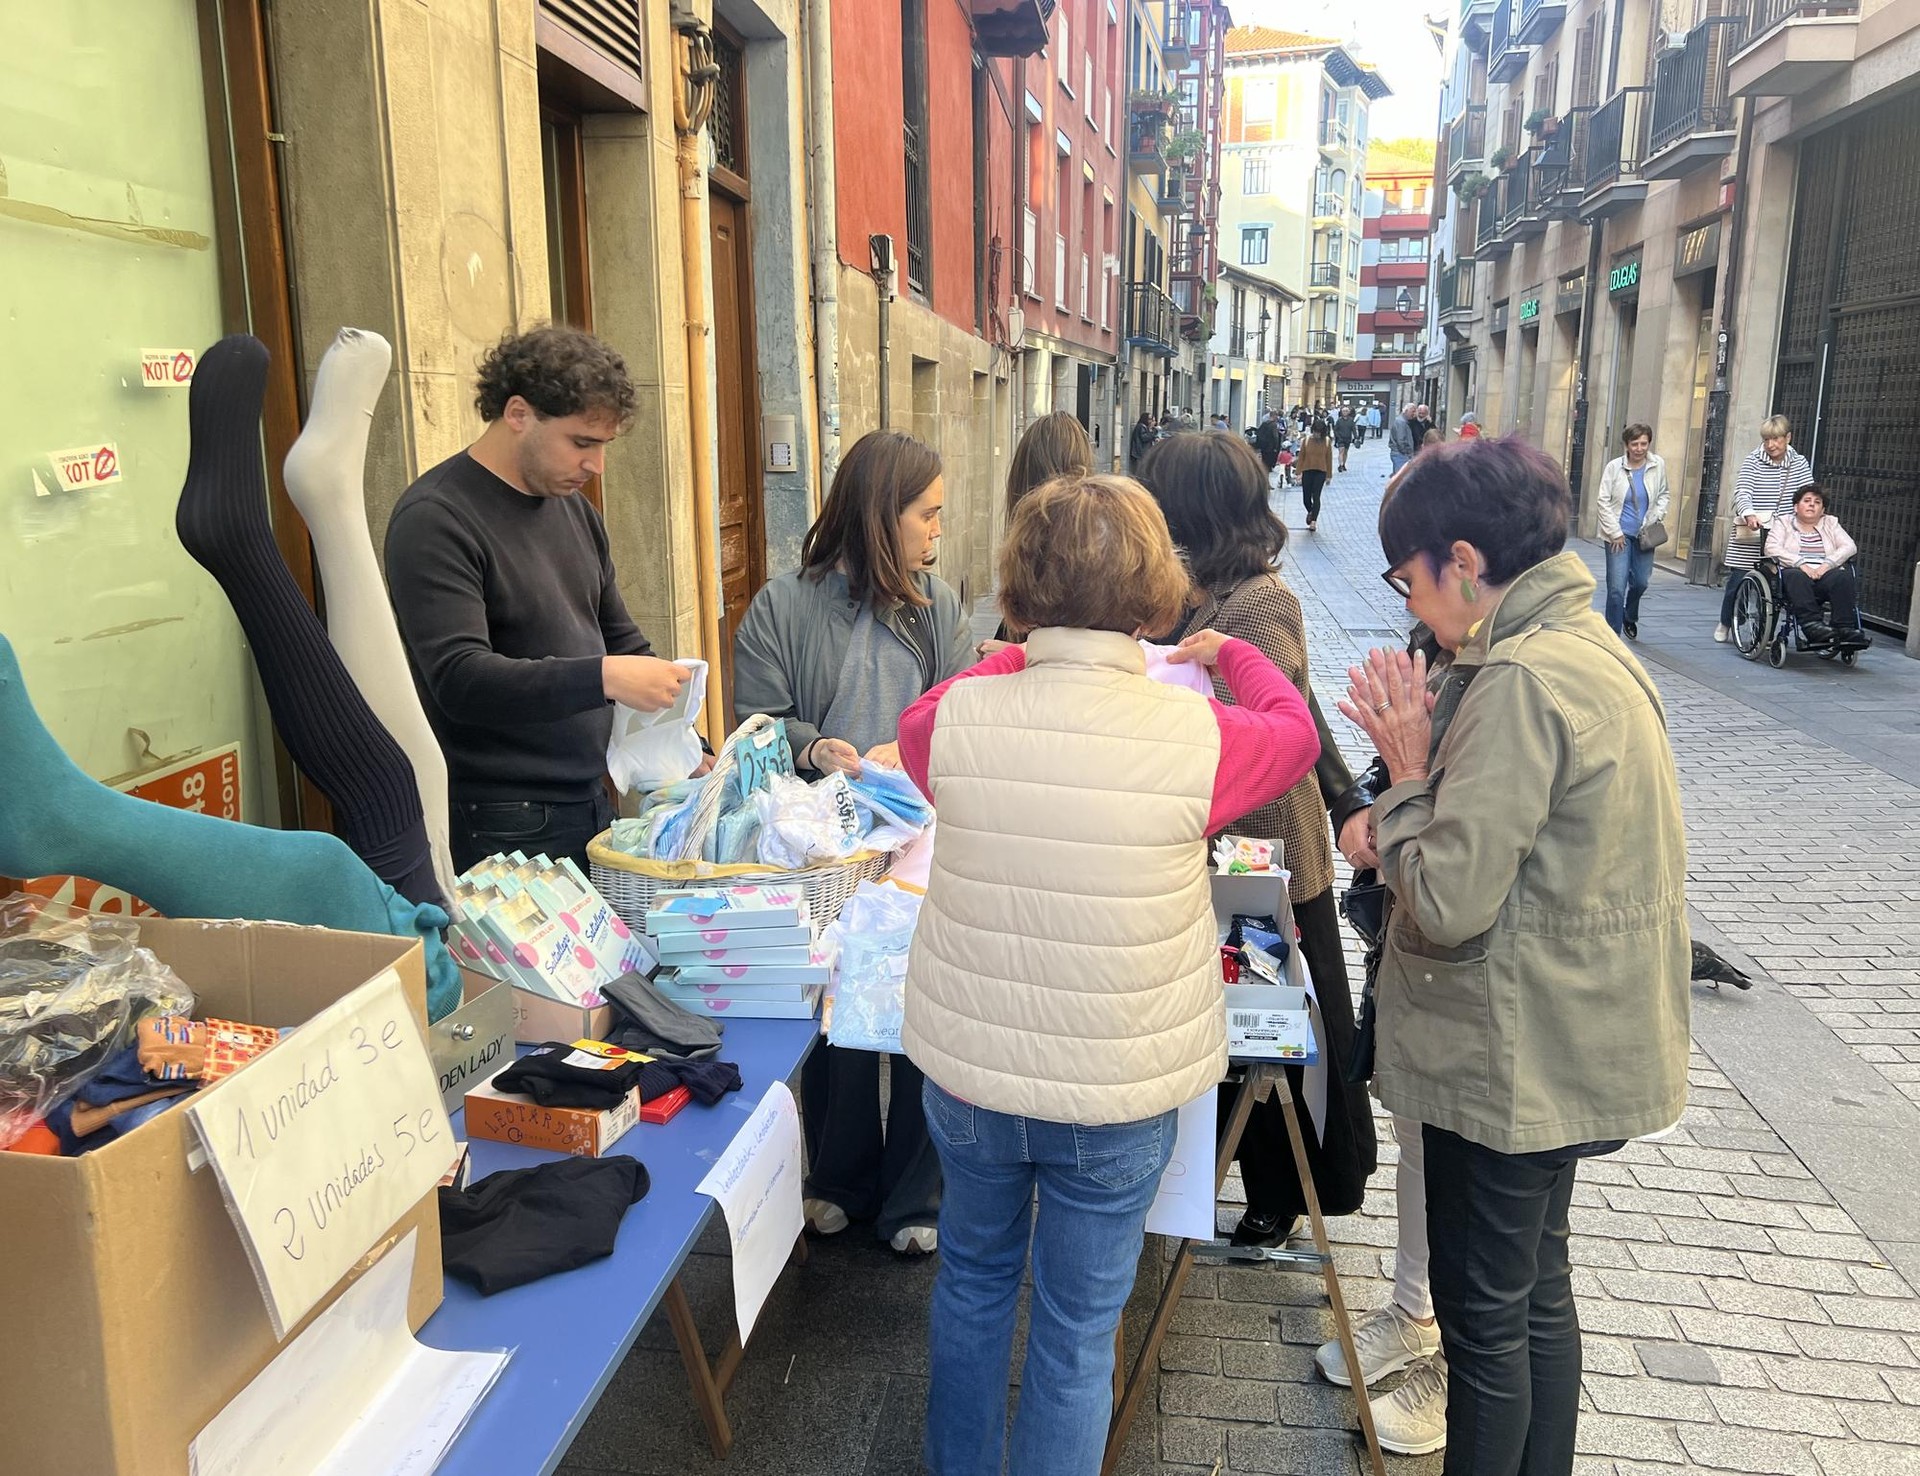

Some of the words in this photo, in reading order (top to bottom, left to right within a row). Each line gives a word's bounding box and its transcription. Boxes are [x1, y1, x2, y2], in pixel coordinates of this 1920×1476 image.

[1610, 262, 1637, 291] DOUGLAS
[1347, 382, 1375, 391] bihar
[470, 1036, 504, 1075] LADY
[273, 1207, 305, 1261] 2
